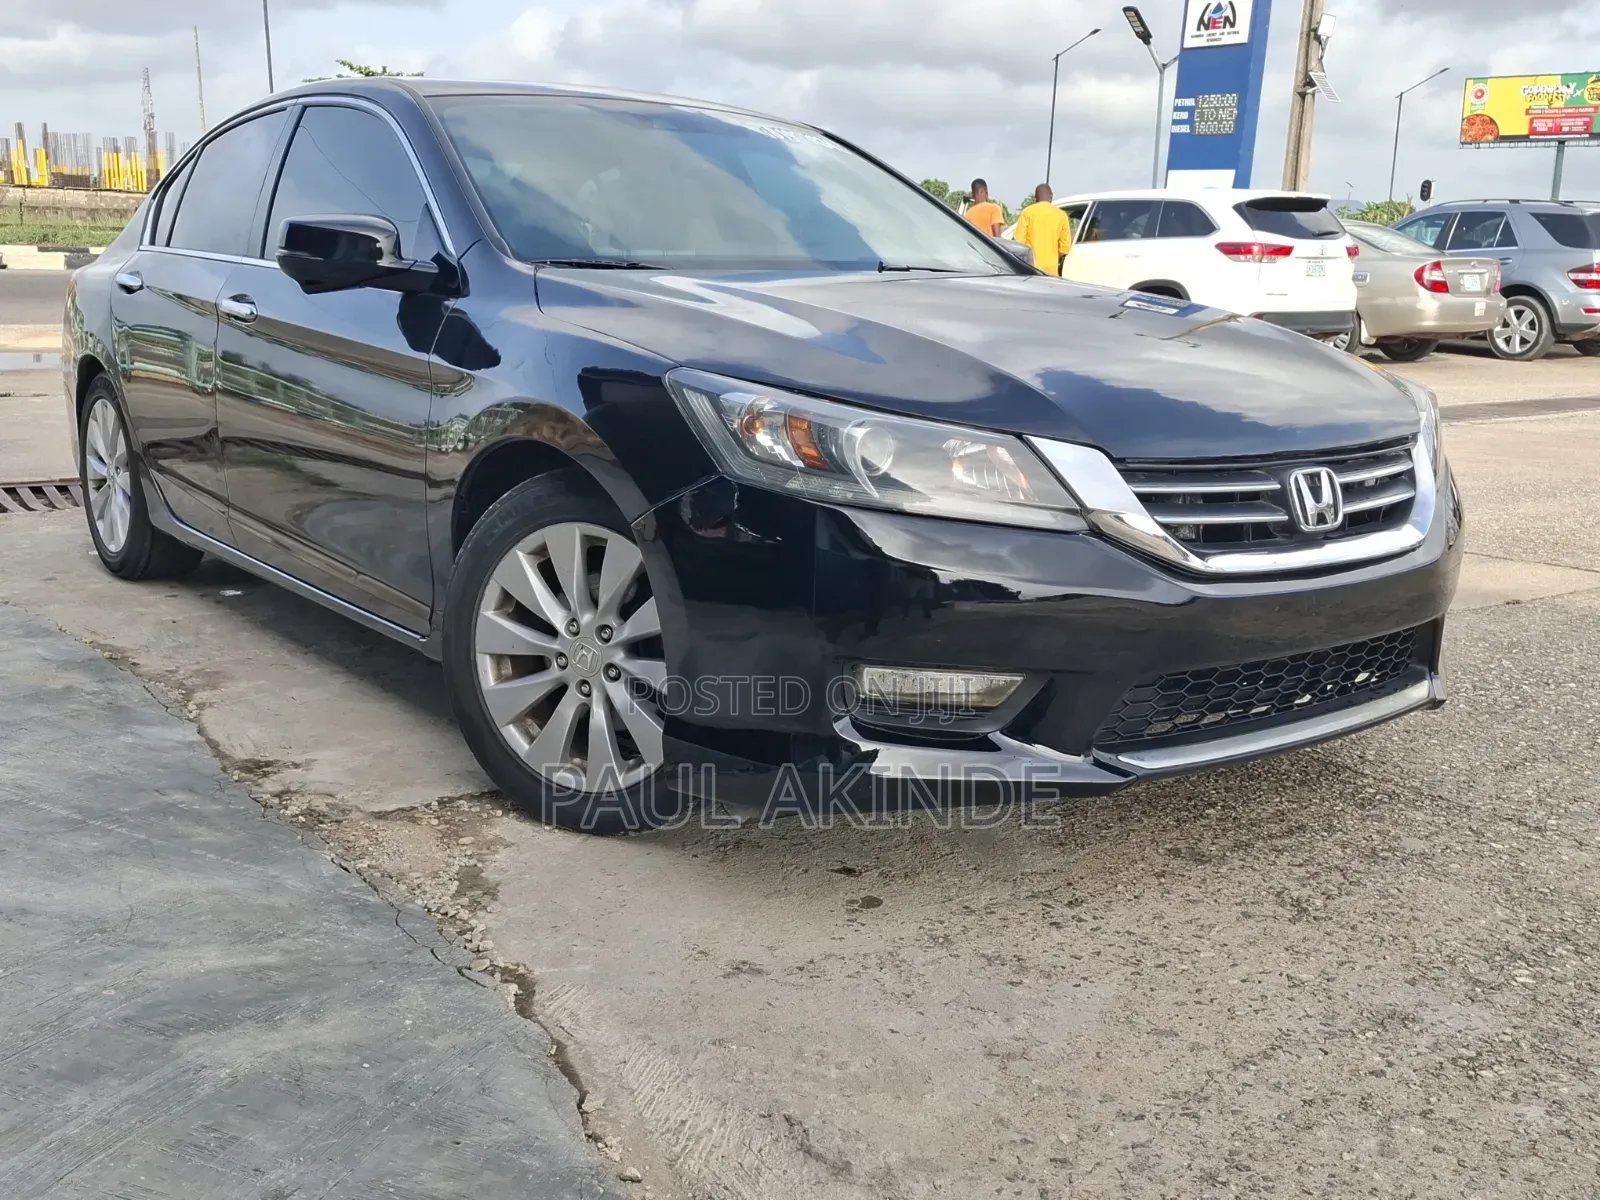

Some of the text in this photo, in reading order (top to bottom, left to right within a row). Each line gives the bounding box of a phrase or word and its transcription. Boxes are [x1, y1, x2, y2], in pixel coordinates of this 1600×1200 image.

[1196, 8, 1237, 31] NEN
[1174, 98, 1195, 107] PETROL
[1172, 111, 1188, 119] KERO
[1171, 125, 1190, 133] DIESEL
